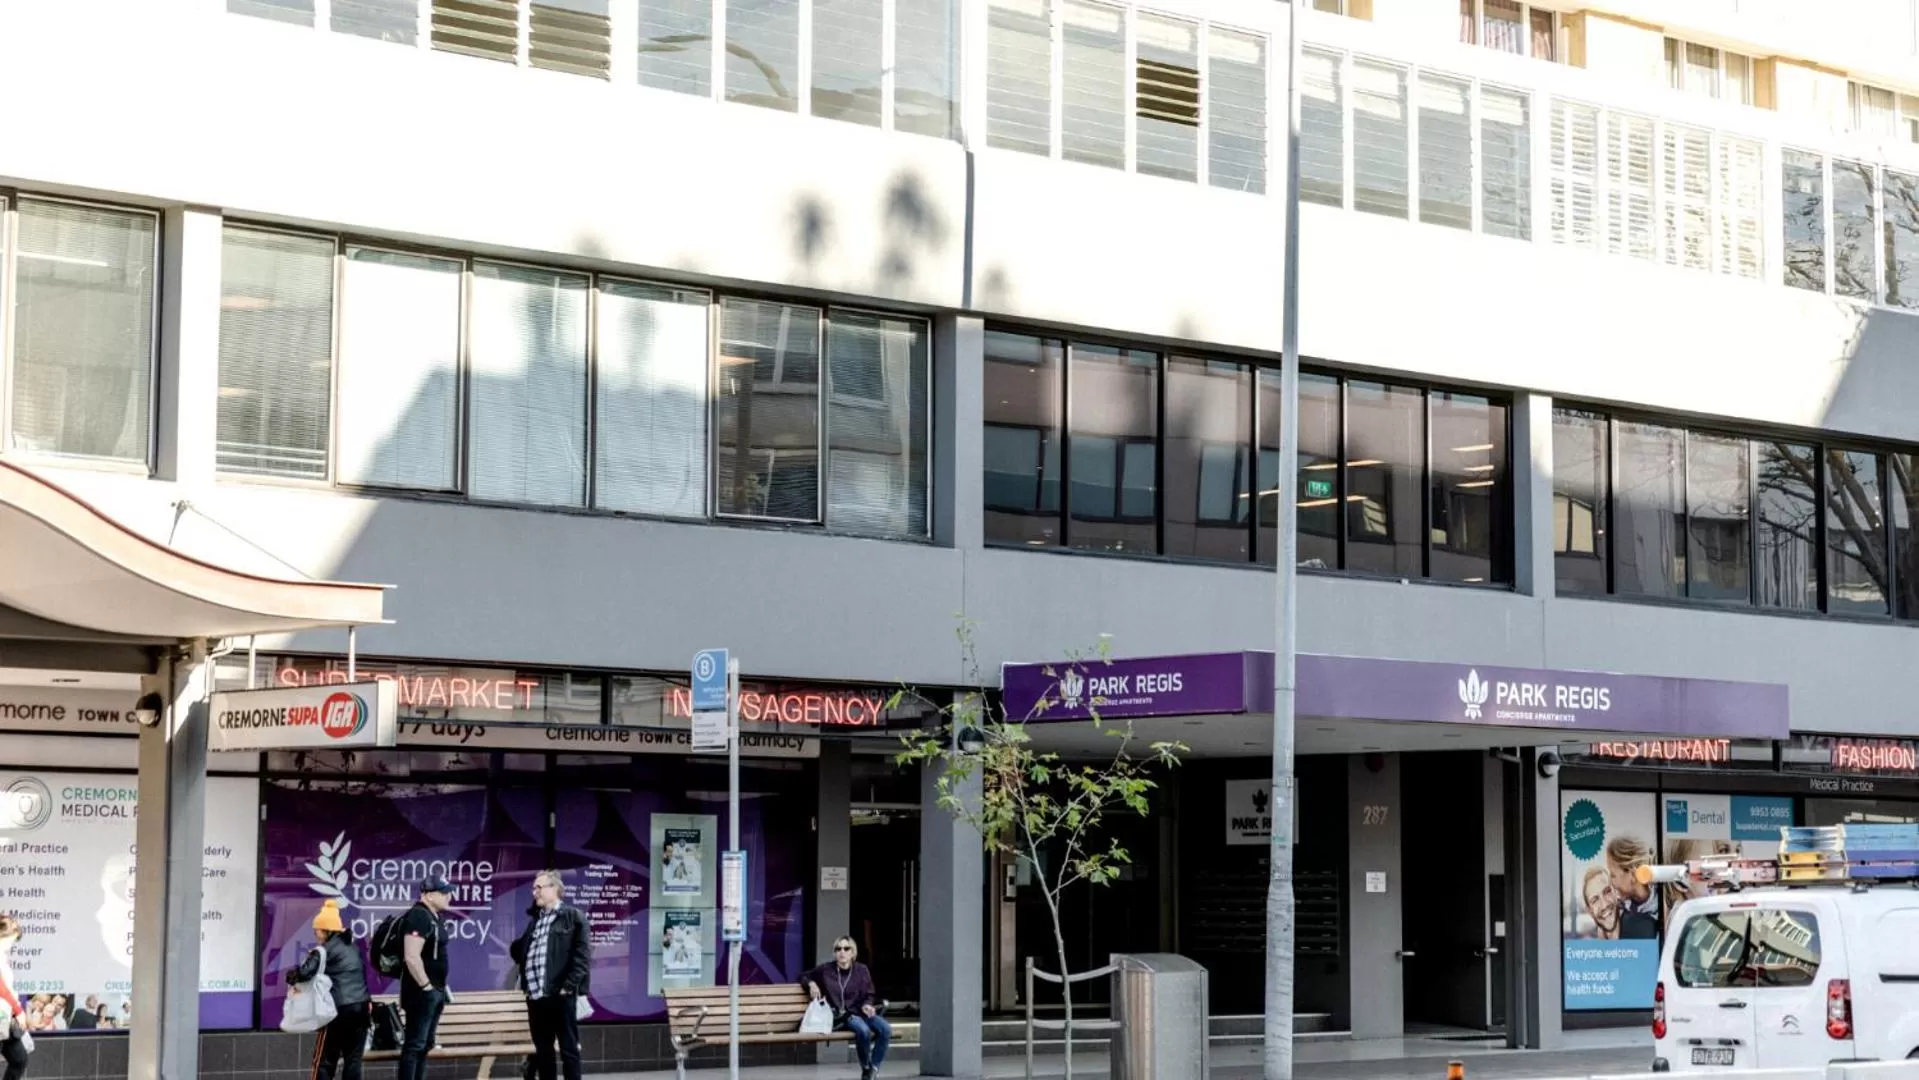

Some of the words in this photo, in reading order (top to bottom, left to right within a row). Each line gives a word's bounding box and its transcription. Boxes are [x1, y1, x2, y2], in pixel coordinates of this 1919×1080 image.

[281, 667, 538, 711] SMARKET
[1089, 675, 1129, 696] PARK
[1136, 672, 1183, 693] REGIS
[1496, 682, 1547, 707] PARK
[1555, 685, 1611, 711] REGIS
[672, 688, 884, 725] NSAGENCY
[77, 709, 119, 722] TOWN
[219, 708, 287, 729] CREMORNE
[288, 706, 319, 726] SUPA
[638, 732, 673, 743] TOWN
[738, 734, 805, 752] armacy
[1598, 739, 1731, 761] RESTAURANT
[1839, 744, 1915, 770] FASHION
[1809, 777, 1840, 791] Medical
[1842, 779, 1874, 792] Practice
[62, 787, 137, 801] CREMORN
[62, 803, 128, 818] MEDICAL
[1363, 805, 1389, 825] 287
[1692, 810, 1726, 825] Dental
[1232, 817, 1259, 830] PARK
[21, 842, 69, 854] Practice
[204, 845, 233, 858] derly
[28, 864, 65, 876] Health
[352, 858, 493, 882] cremorne
[8, 886, 46, 898] Health
[352, 883, 411, 901] TOWN
[449, 885, 493, 901] NTRE
[9, 909, 61, 920] Medicine
[202, 910, 222, 921] alth
[20, 924, 56, 935] ations
[351, 911, 493, 945] phacy
[10, 945, 43, 957] Fever
[1566, 947, 1603, 960] Everyone
[1605, 946, 1639, 959] welcome
[1567, 970, 1580, 981] We
[1582, 970, 1608, 983] accept
[1567, 983, 1591, 996] health
[1593, 983, 1614, 994] funds
